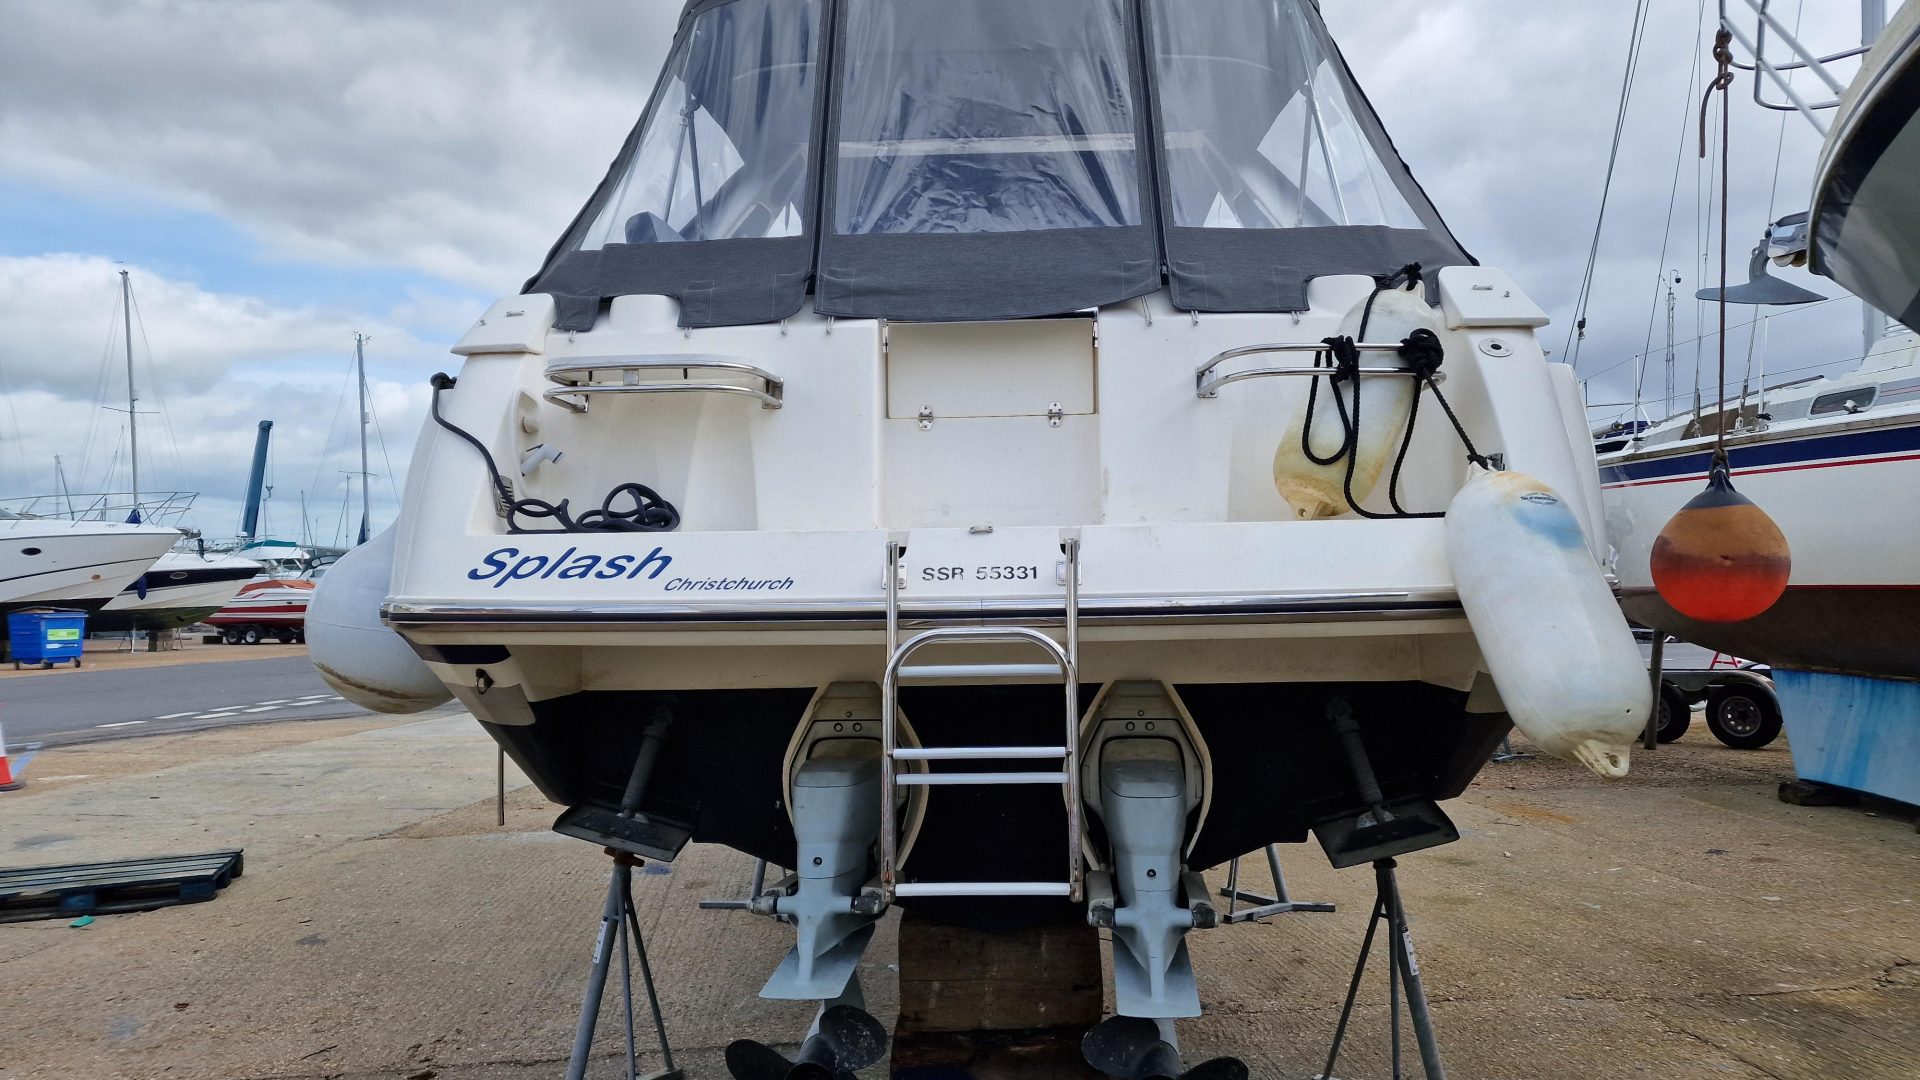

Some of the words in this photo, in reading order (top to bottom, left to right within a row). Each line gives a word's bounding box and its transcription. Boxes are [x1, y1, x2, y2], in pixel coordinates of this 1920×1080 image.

[467, 546, 673, 588] Splash
[922, 567, 964, 581] SSR
[976, 566, 1037, 580] 55331
[663, 577, 794, 592] Christchurch
